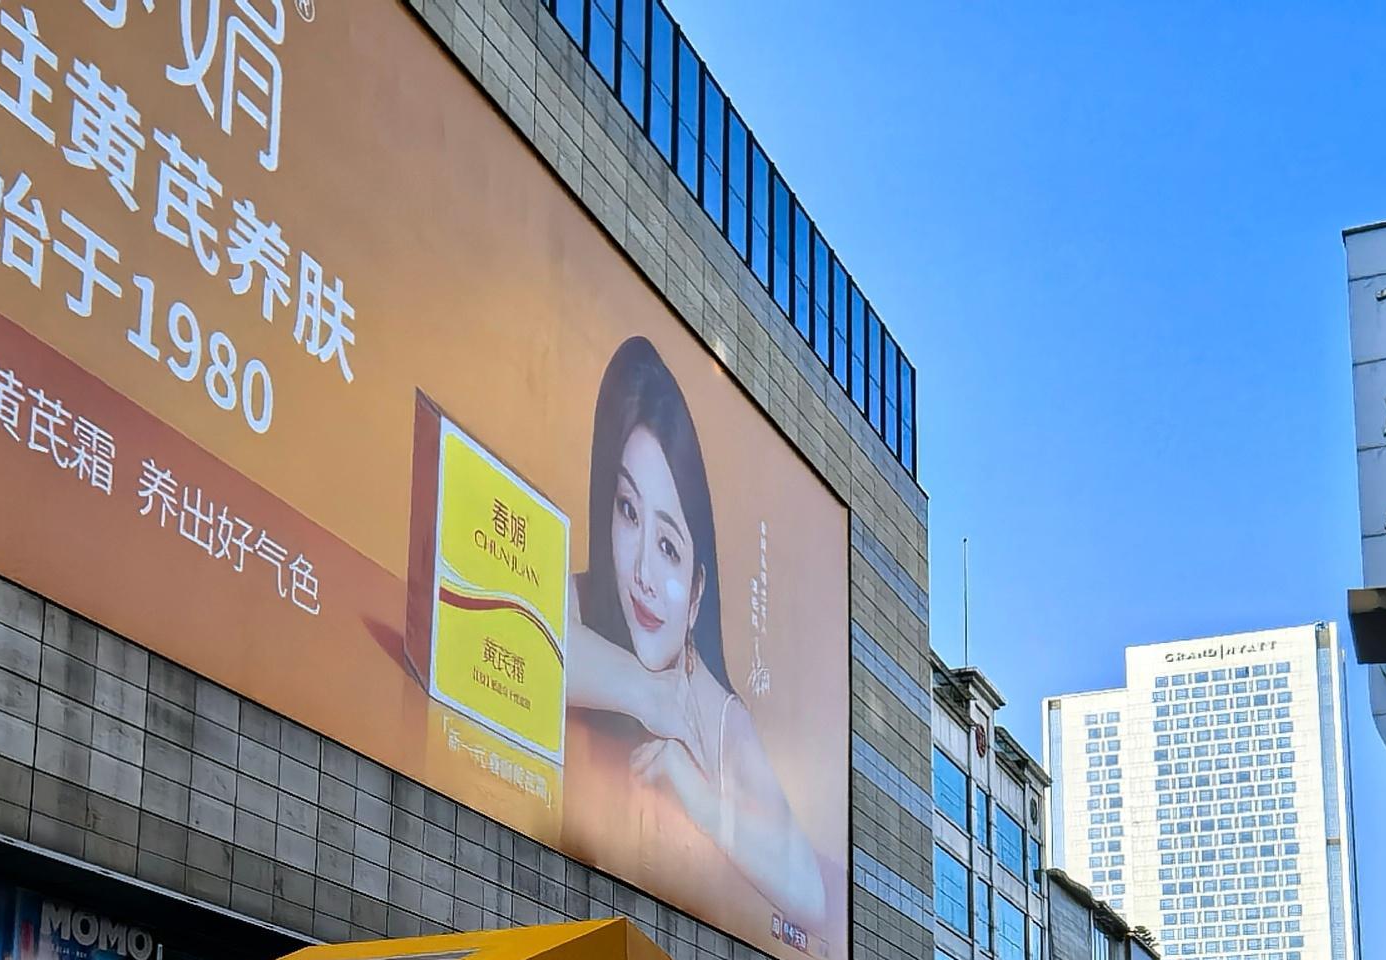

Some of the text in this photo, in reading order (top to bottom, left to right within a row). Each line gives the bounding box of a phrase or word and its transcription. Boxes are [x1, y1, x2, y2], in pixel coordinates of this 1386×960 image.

[138, 458, 321, 616] 养出好气色
[492, 498, 528, 553] 春娟
[1165, 641, 1277, 662] GRAND HYATT
